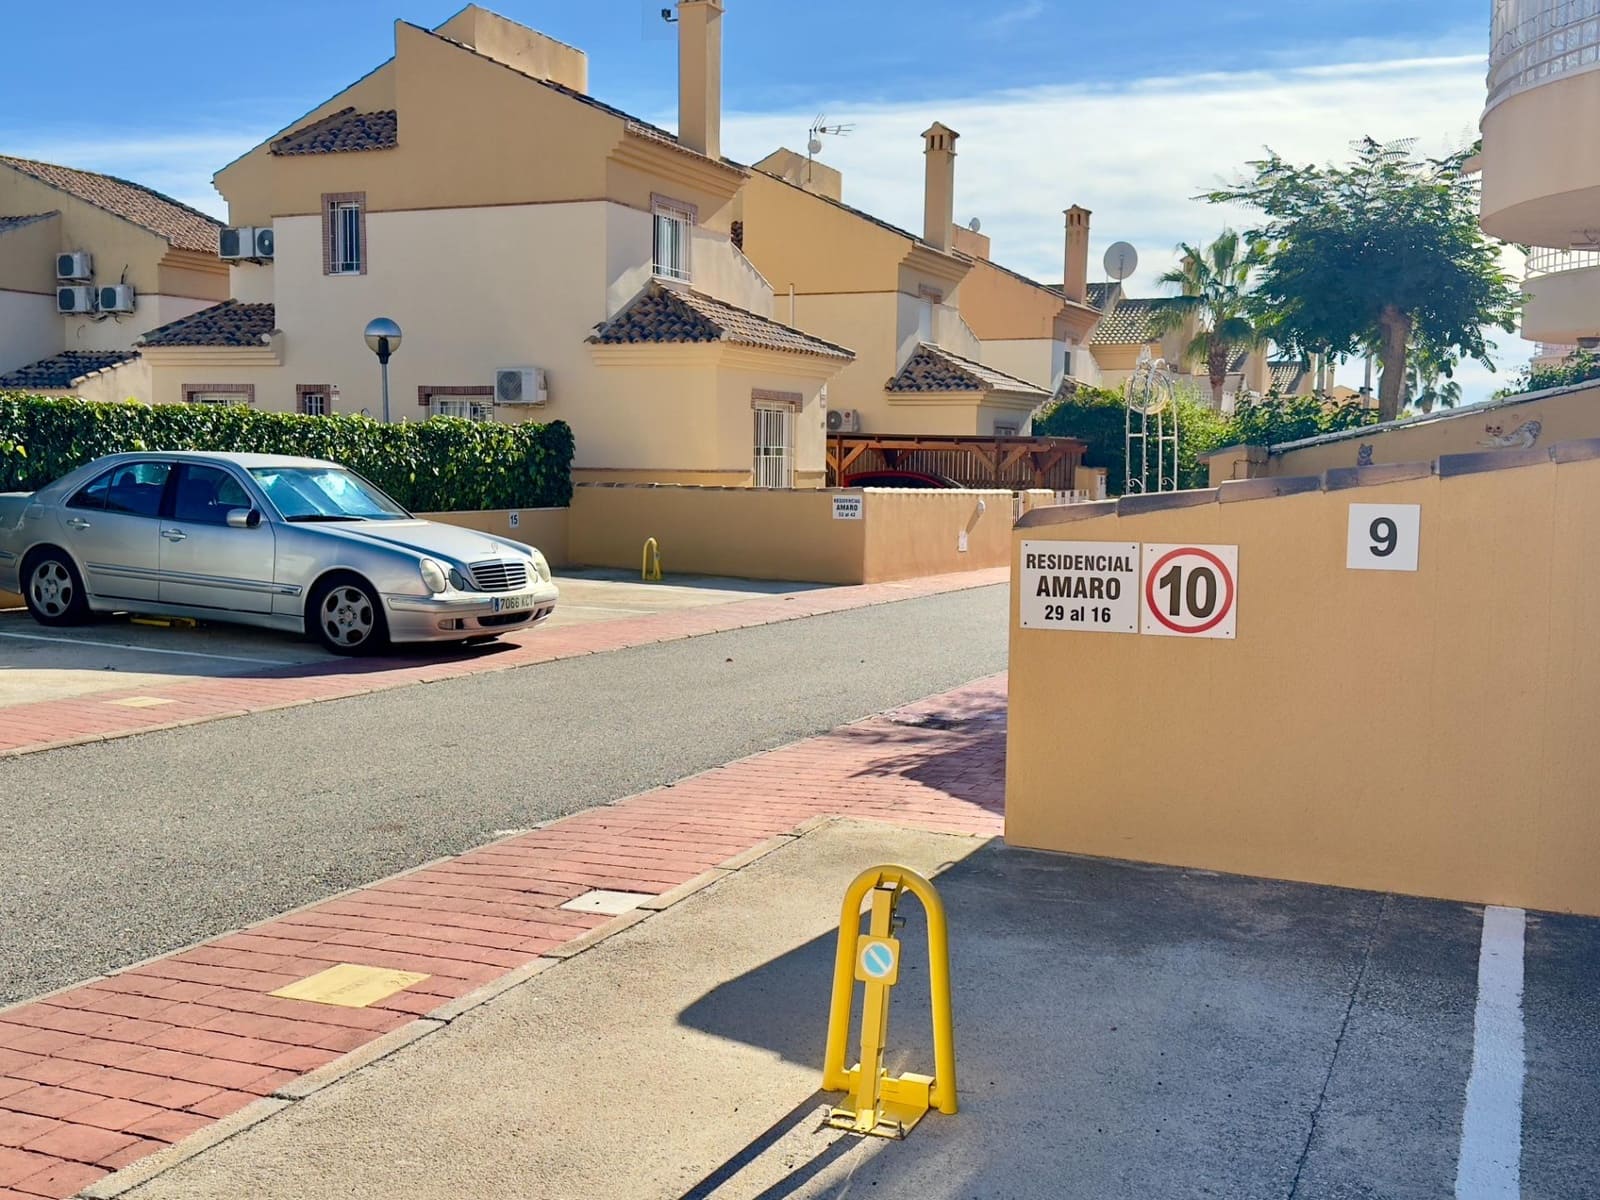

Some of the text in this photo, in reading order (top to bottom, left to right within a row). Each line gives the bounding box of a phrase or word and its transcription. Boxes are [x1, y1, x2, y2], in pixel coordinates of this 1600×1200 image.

[510, 514, 518, 525] 15
[1369, 516, 1398, 557] 9
[1026, 553, 1133, 572] RESIDENCIAL
[1036, 575, 1121, 600] AMARO
[1159, 565, 1217, 618] 10
[1044, 605, 1111, 623] 29 al 16
